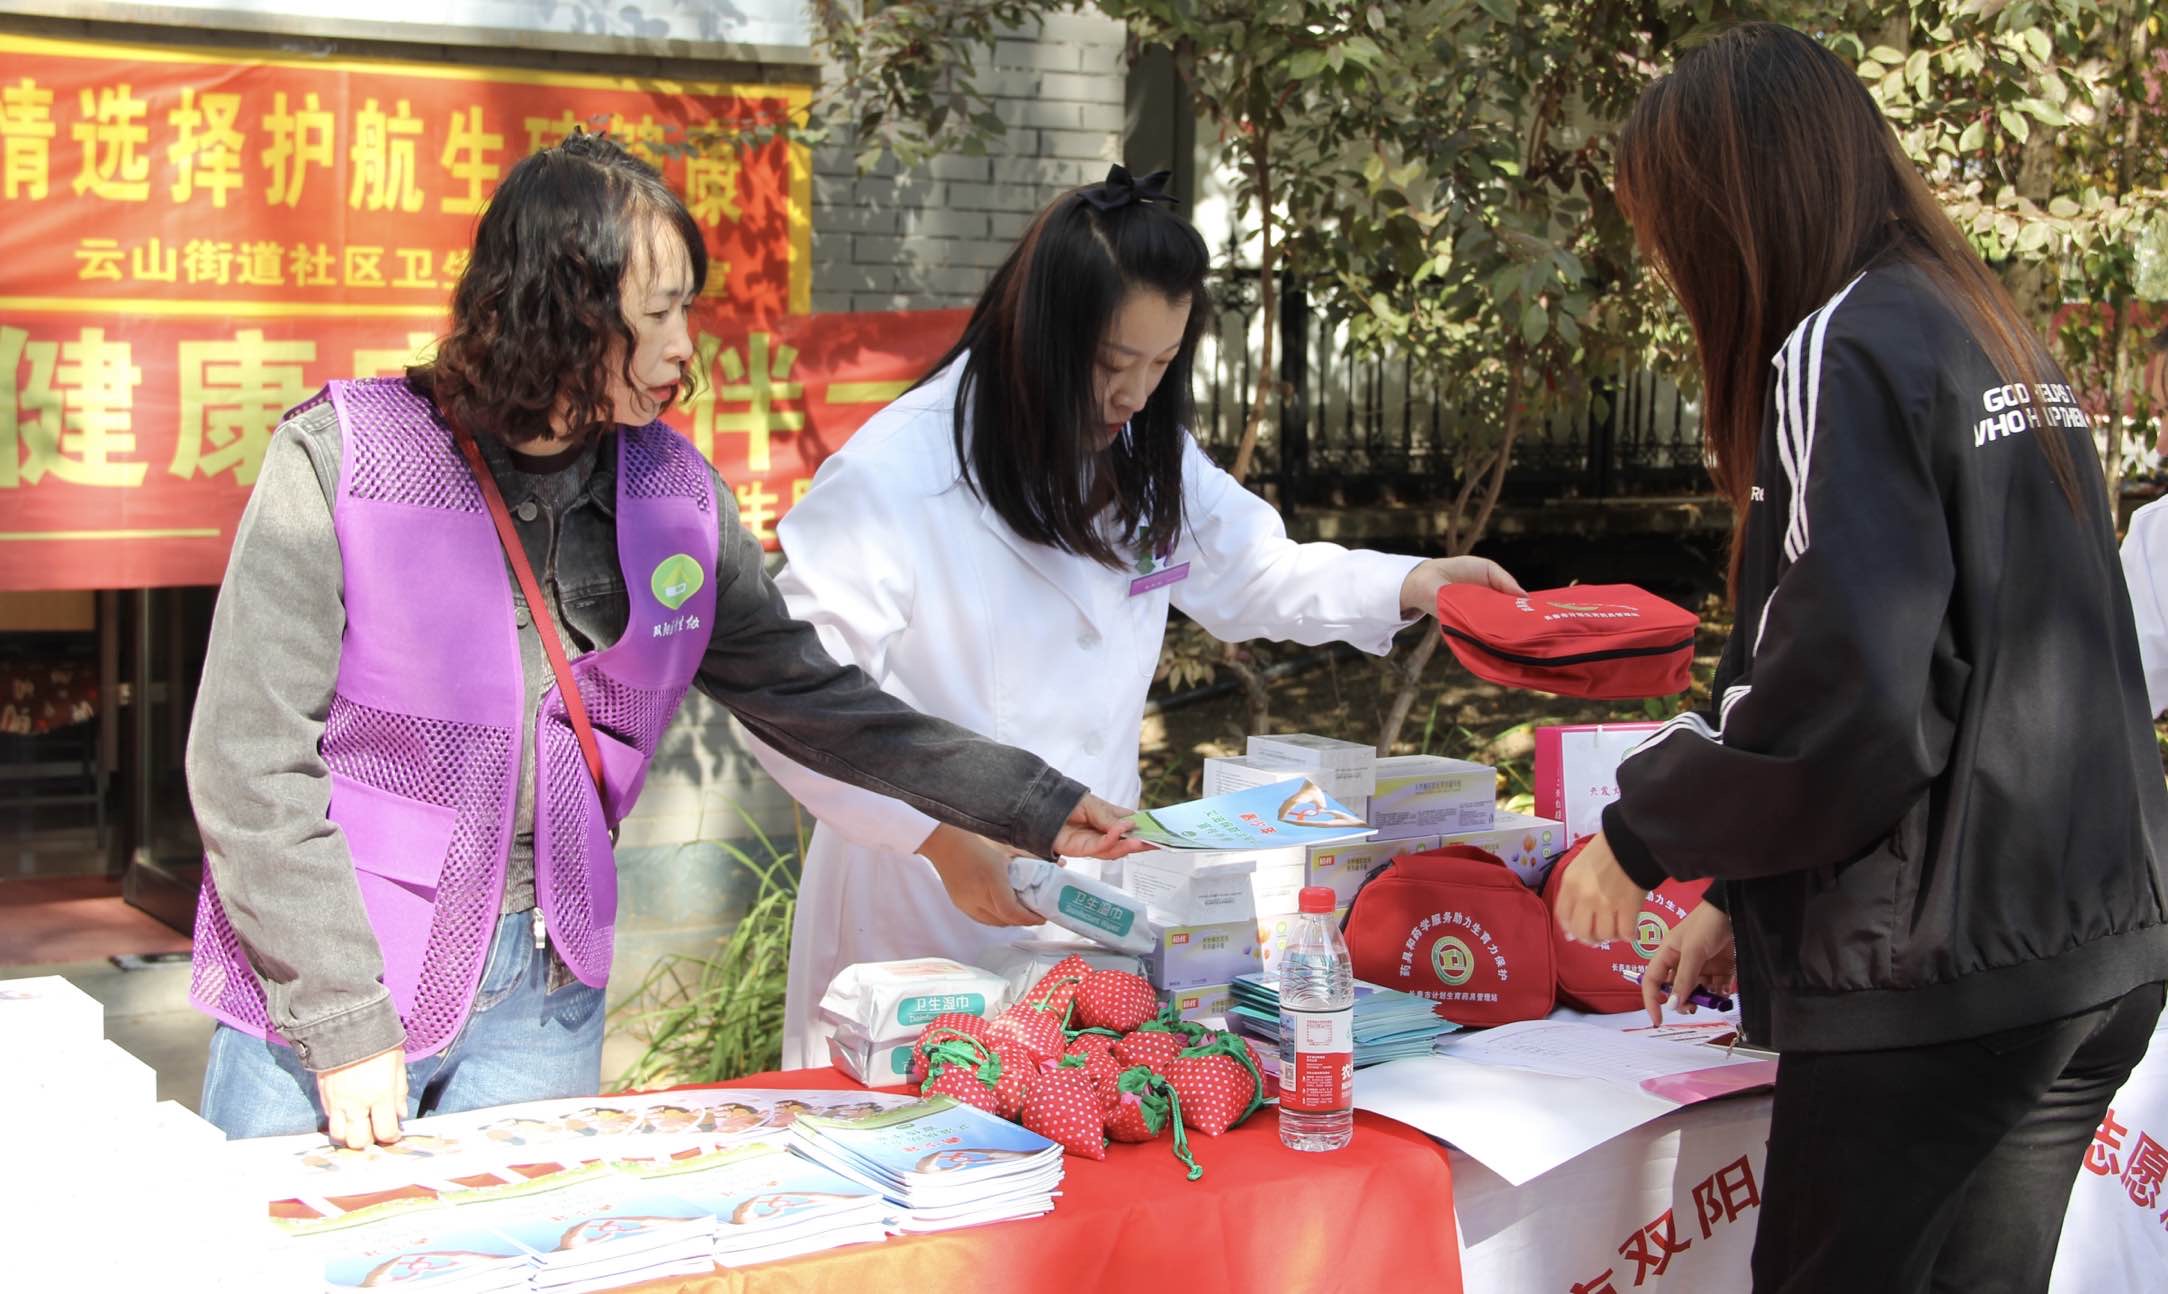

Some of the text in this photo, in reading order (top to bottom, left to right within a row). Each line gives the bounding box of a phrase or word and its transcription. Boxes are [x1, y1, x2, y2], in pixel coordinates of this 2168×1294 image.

[1983, 382, 2031, 413] GOD
[2026, 406, 2061, 429] HLP
[1399, 911, 1508, 981] 药具和药学服务助力生育力保护
[912, 995, 970, 1012] 卫生湿巾
